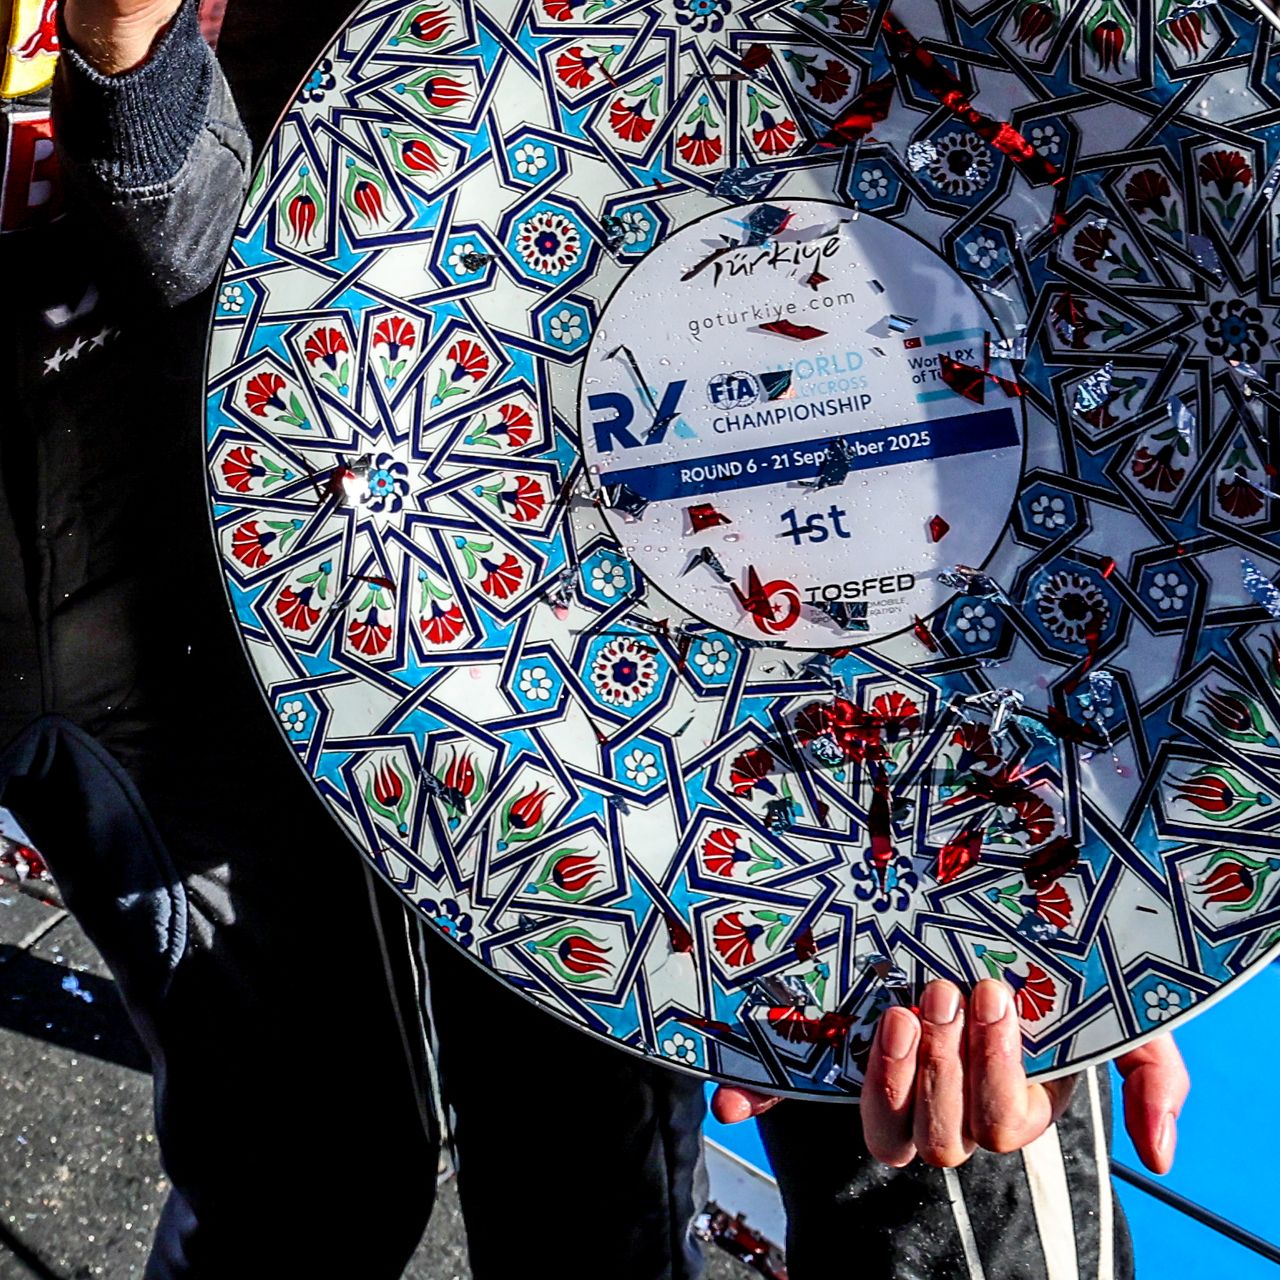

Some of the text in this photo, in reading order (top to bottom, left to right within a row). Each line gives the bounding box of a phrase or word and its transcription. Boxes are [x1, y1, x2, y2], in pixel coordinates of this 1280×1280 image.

[688, 292, 856, 337] goturkiye.com
[766, 351, 864, 380] ORLD
[912, 370, 927, 384] of
[588, 378, 698, 453] RX
[712, 393, 873, 435] CHAMPIONSHIP
[680, 461, 743, 484] ROUND
[746, 458, 758, 474] 6
[773, 453, 791, 470] 21
[793, 440, 885, 469] Septber
[890, 430, 932, 452] 2025
[780, 504, 852, 547] 1st
[804, 573, 915, 603] TOSFED
